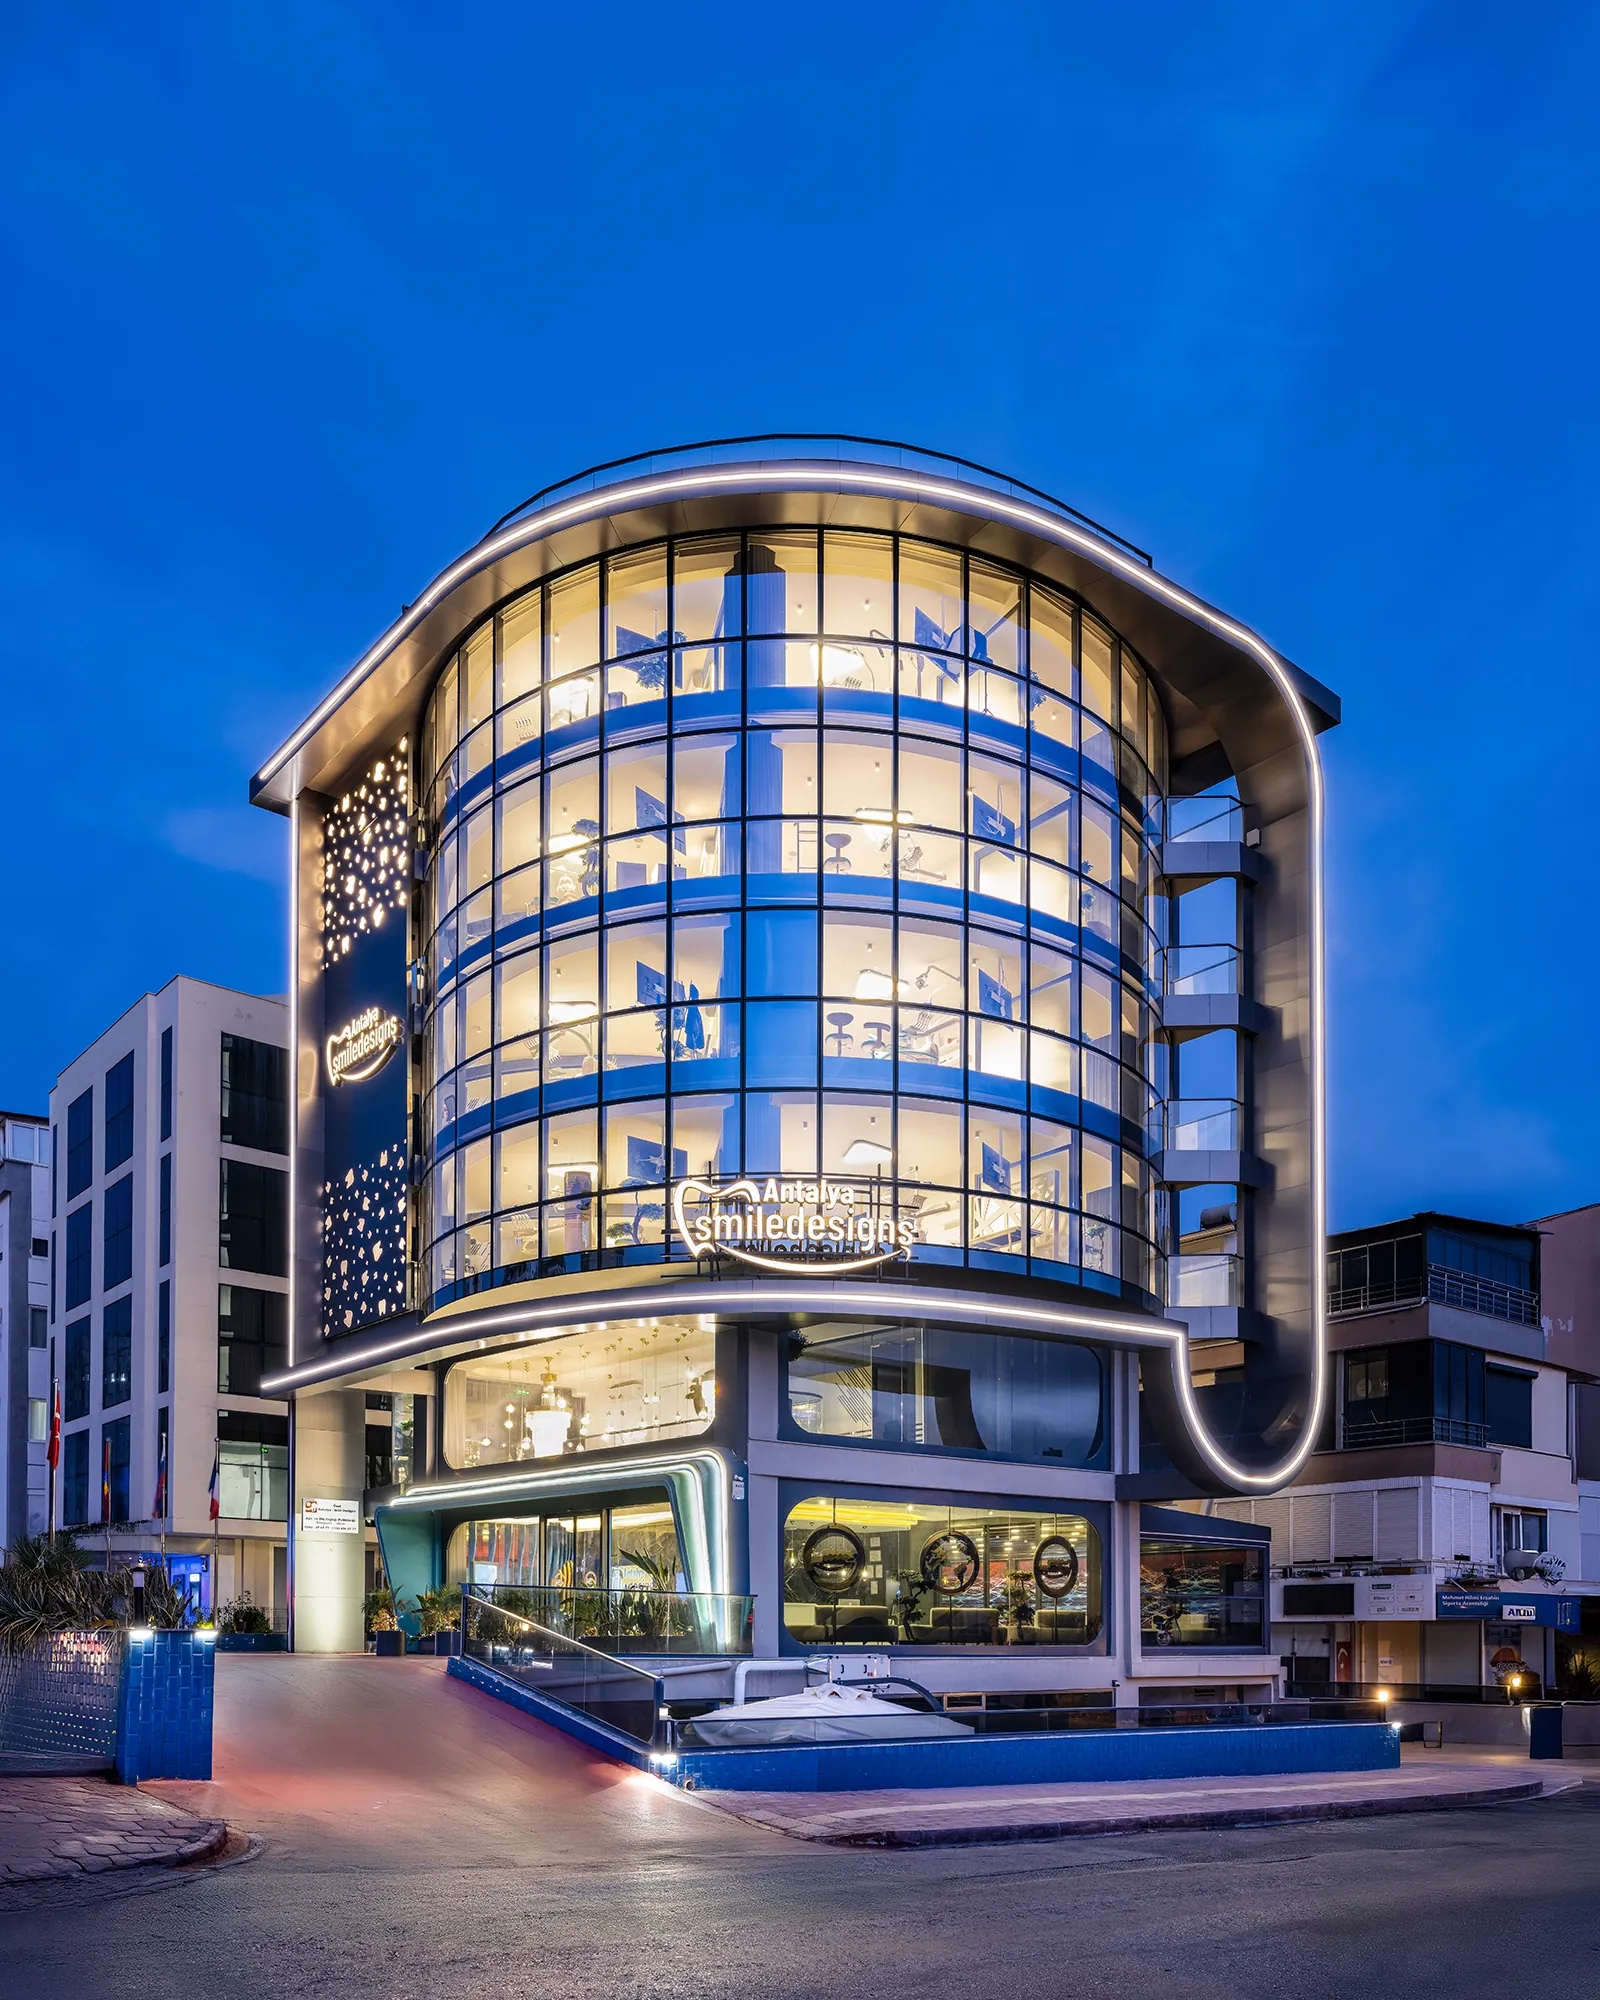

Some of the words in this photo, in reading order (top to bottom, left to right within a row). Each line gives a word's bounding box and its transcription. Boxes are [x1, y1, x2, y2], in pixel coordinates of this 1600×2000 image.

[351, 1007, 379, 1037] Antalya
[332, 1016, 398, 1074] smiledesigns
[763, 1178, 855, 1211] Antalya
[695, 1205, 914, 1251] smiledesigns
